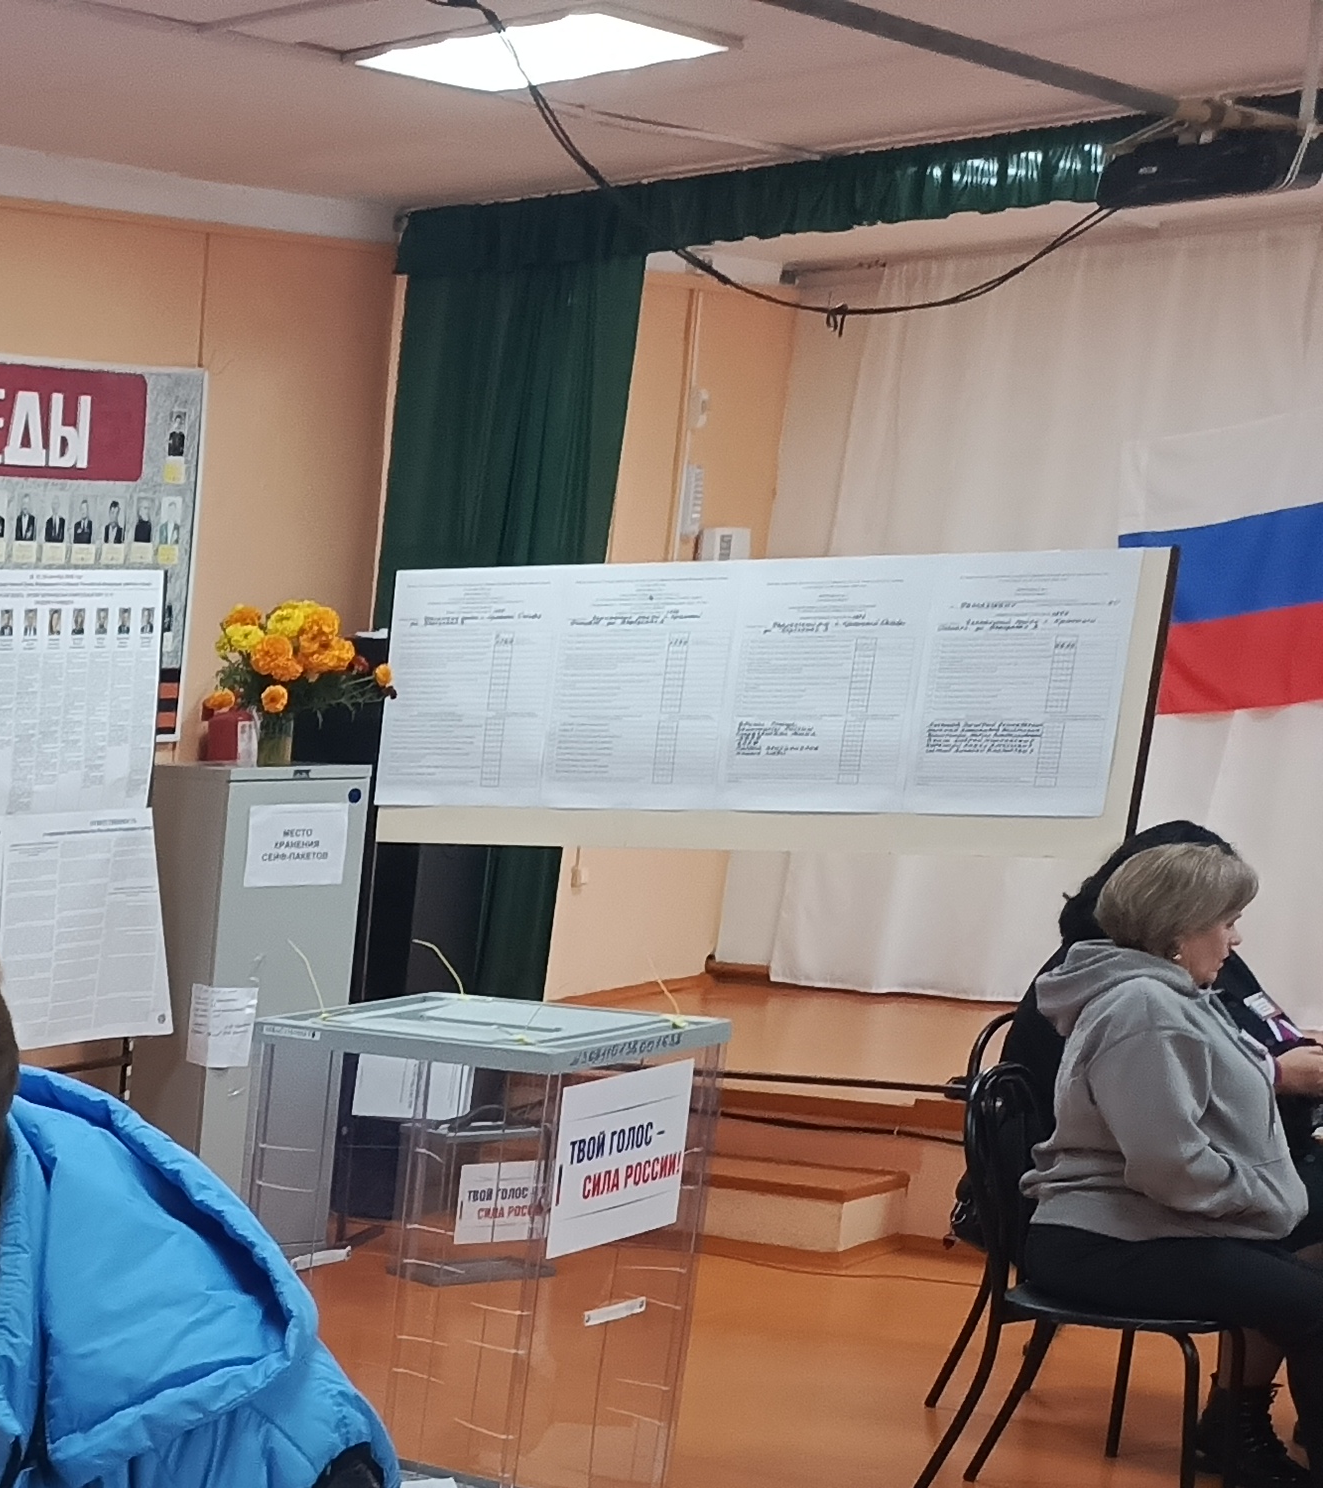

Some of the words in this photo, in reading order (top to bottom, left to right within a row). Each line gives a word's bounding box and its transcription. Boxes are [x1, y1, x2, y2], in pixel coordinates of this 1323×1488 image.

[282, 828, 313, 838] МЕСТО
[273, 839, 320, 850] ХРАНЕНИЯ
[261, 851, 328, 863] СЕЙФ-ПАКЕТОВ
[569, 1130, 607, 1166] ТВОЙ
[608, 1121, 654, 1155] ГОЛОС
[582, 1165, 621, 1200] СИЛА
[624, 1151, 682, 1190] РОССИИ!
[467, 1188, 494, 1202] ТВОЙ
[497, 1186, 529, 1200] ГОЛОС
[477, 1206, 505, 1221] СИЛА
